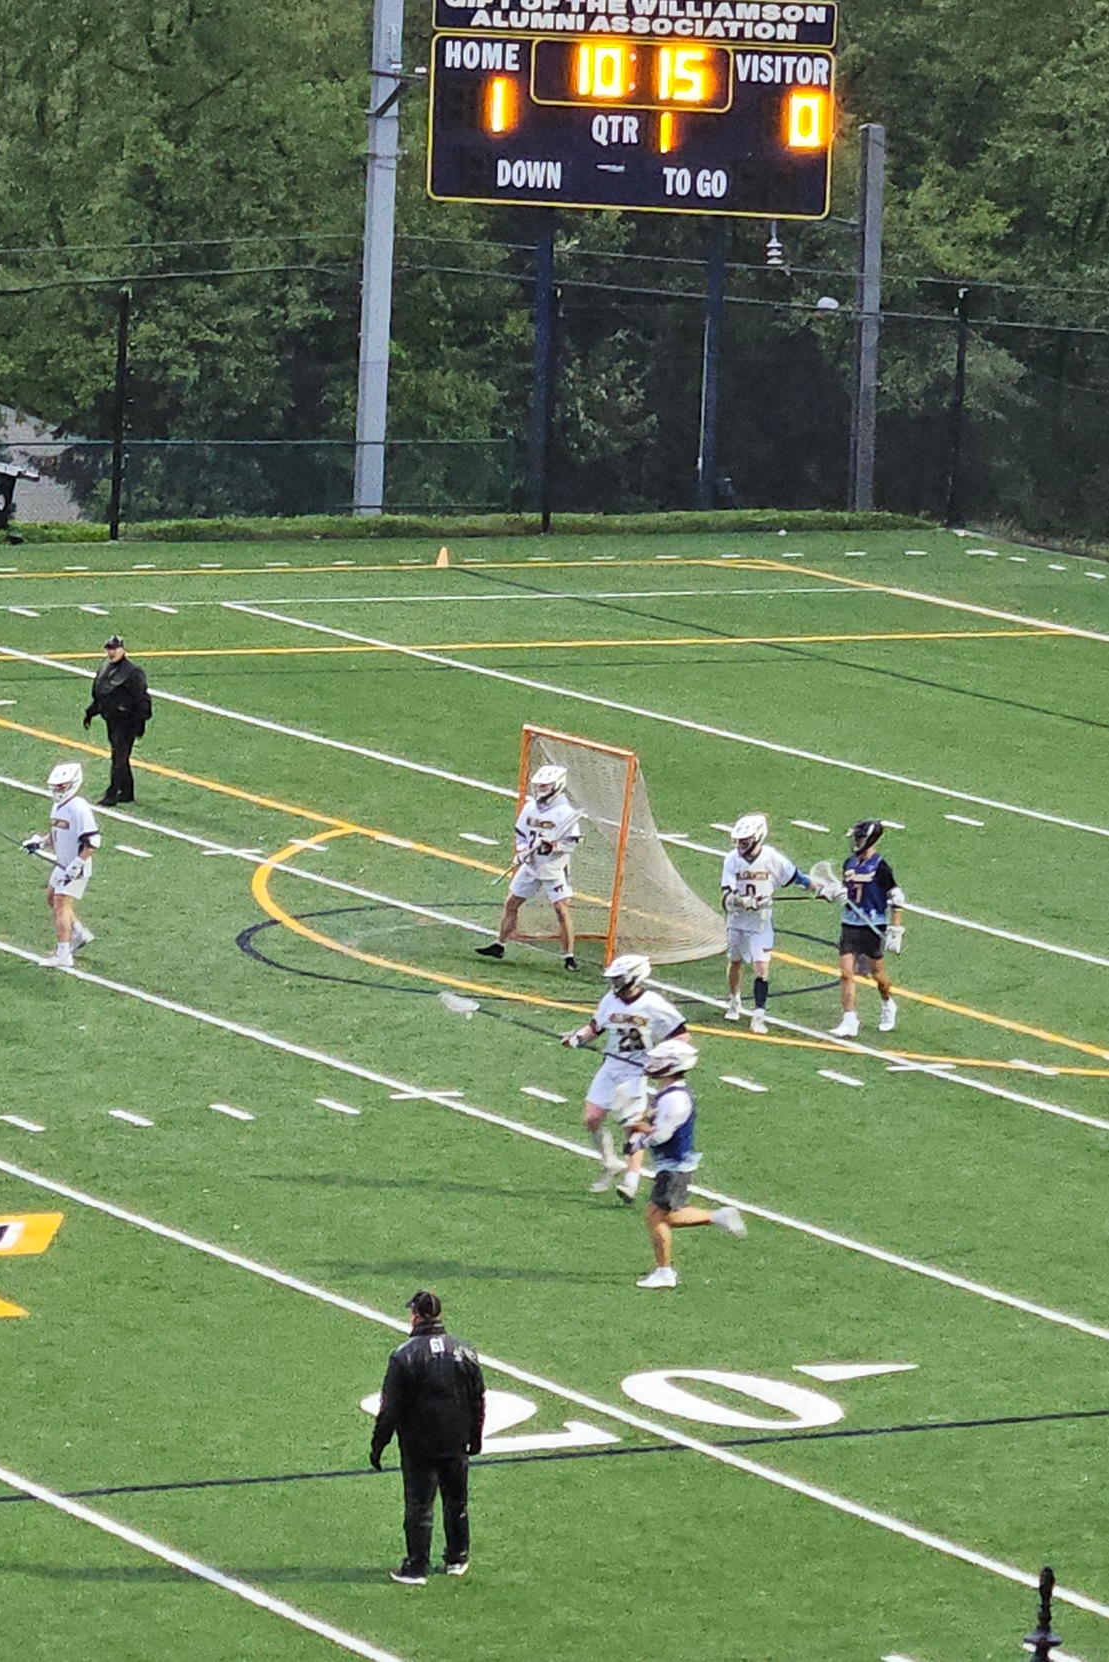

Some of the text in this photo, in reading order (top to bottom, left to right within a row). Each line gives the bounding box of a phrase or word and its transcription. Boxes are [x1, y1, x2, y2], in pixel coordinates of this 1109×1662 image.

[470, 9, 797, 41] ALUMNI ASSOCIATION
[568, 0, 628, 14] THE
[630, 0, 827, 23] WILLIAMSON
[445, 41, 520, 71] HOME
[735, 54, 830, 86] VISITOR
[490, 76, 508, 132] 1
[788, 92, 823, 147] 0
[592, 114, 639, 146] QTR
[660, 112, 673, 153] 1
[497, 159, 562, 190] DOWN
[663, 166, 727, 198] TO GO
